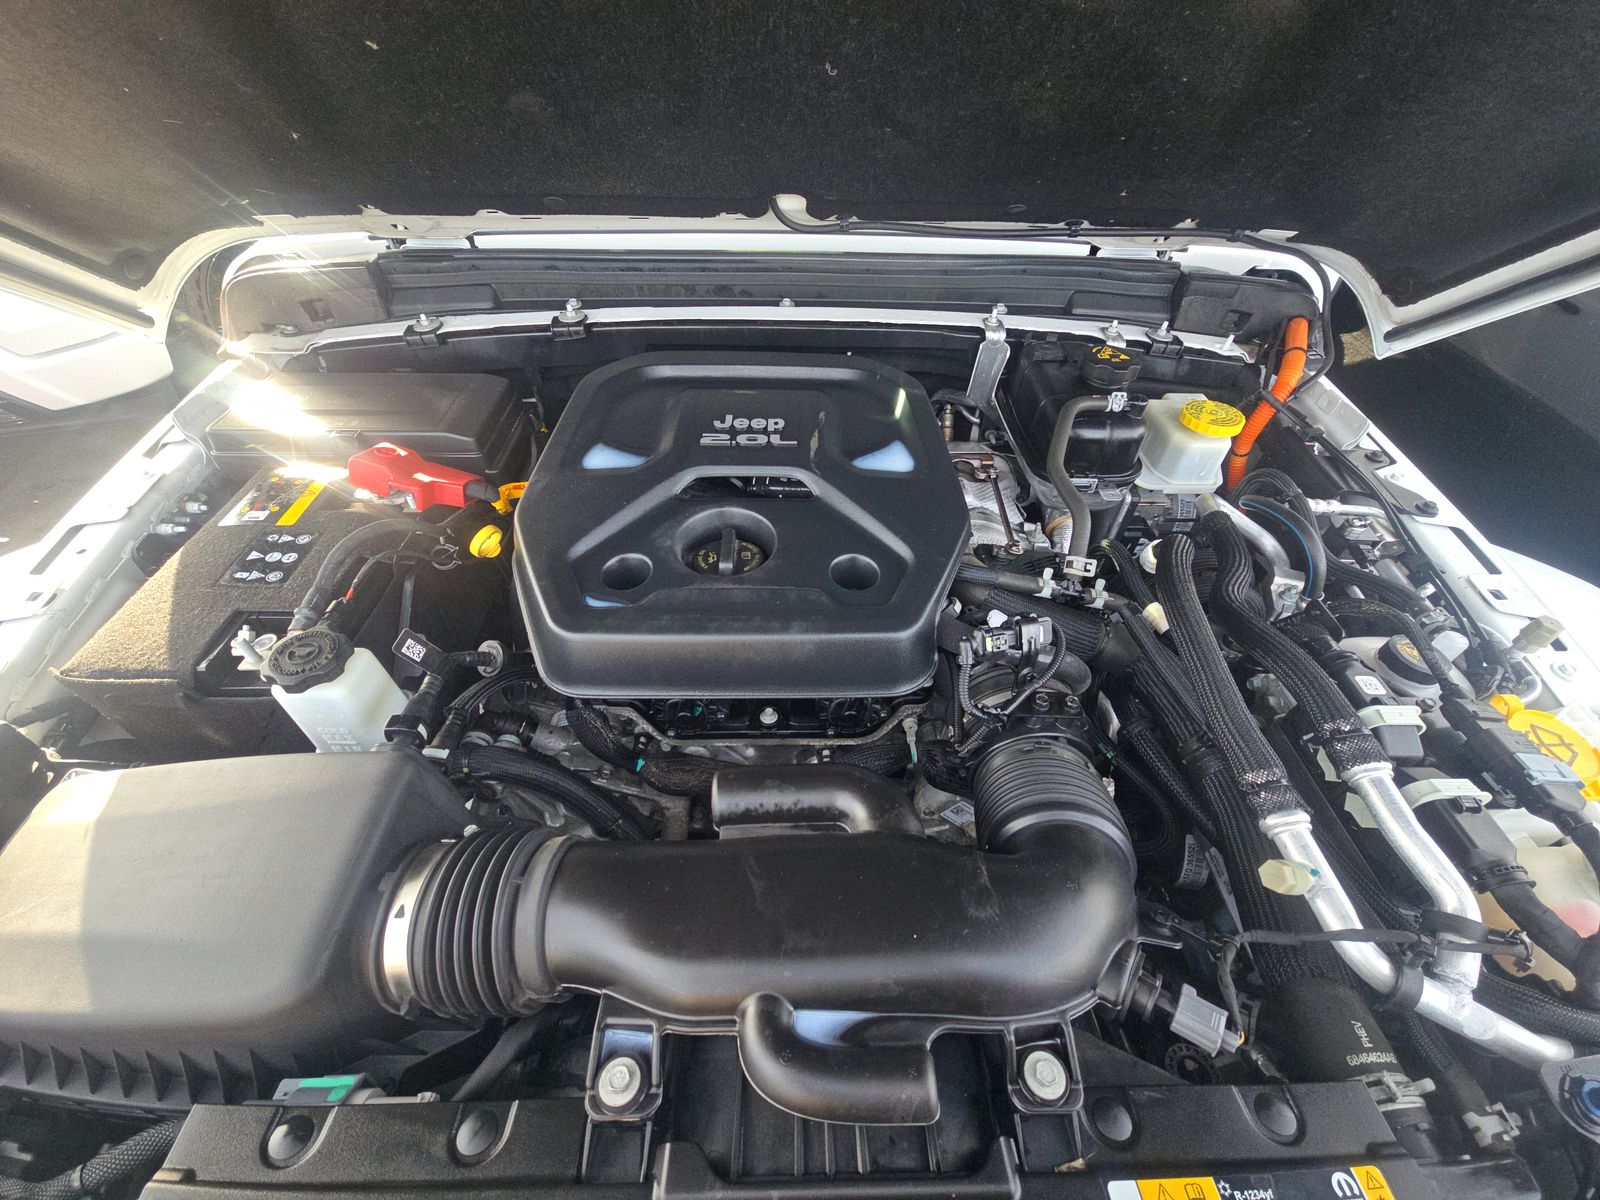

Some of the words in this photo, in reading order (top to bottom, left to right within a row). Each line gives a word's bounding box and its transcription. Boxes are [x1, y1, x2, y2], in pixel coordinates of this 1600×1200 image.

[713, 414, 785, 431] Jeep
[699, 433, 798, 447] 2.0L
[1350, 1020, 1374, 1048] PHEV
[1233, 1188, 1274, 1200] R-1234yf
